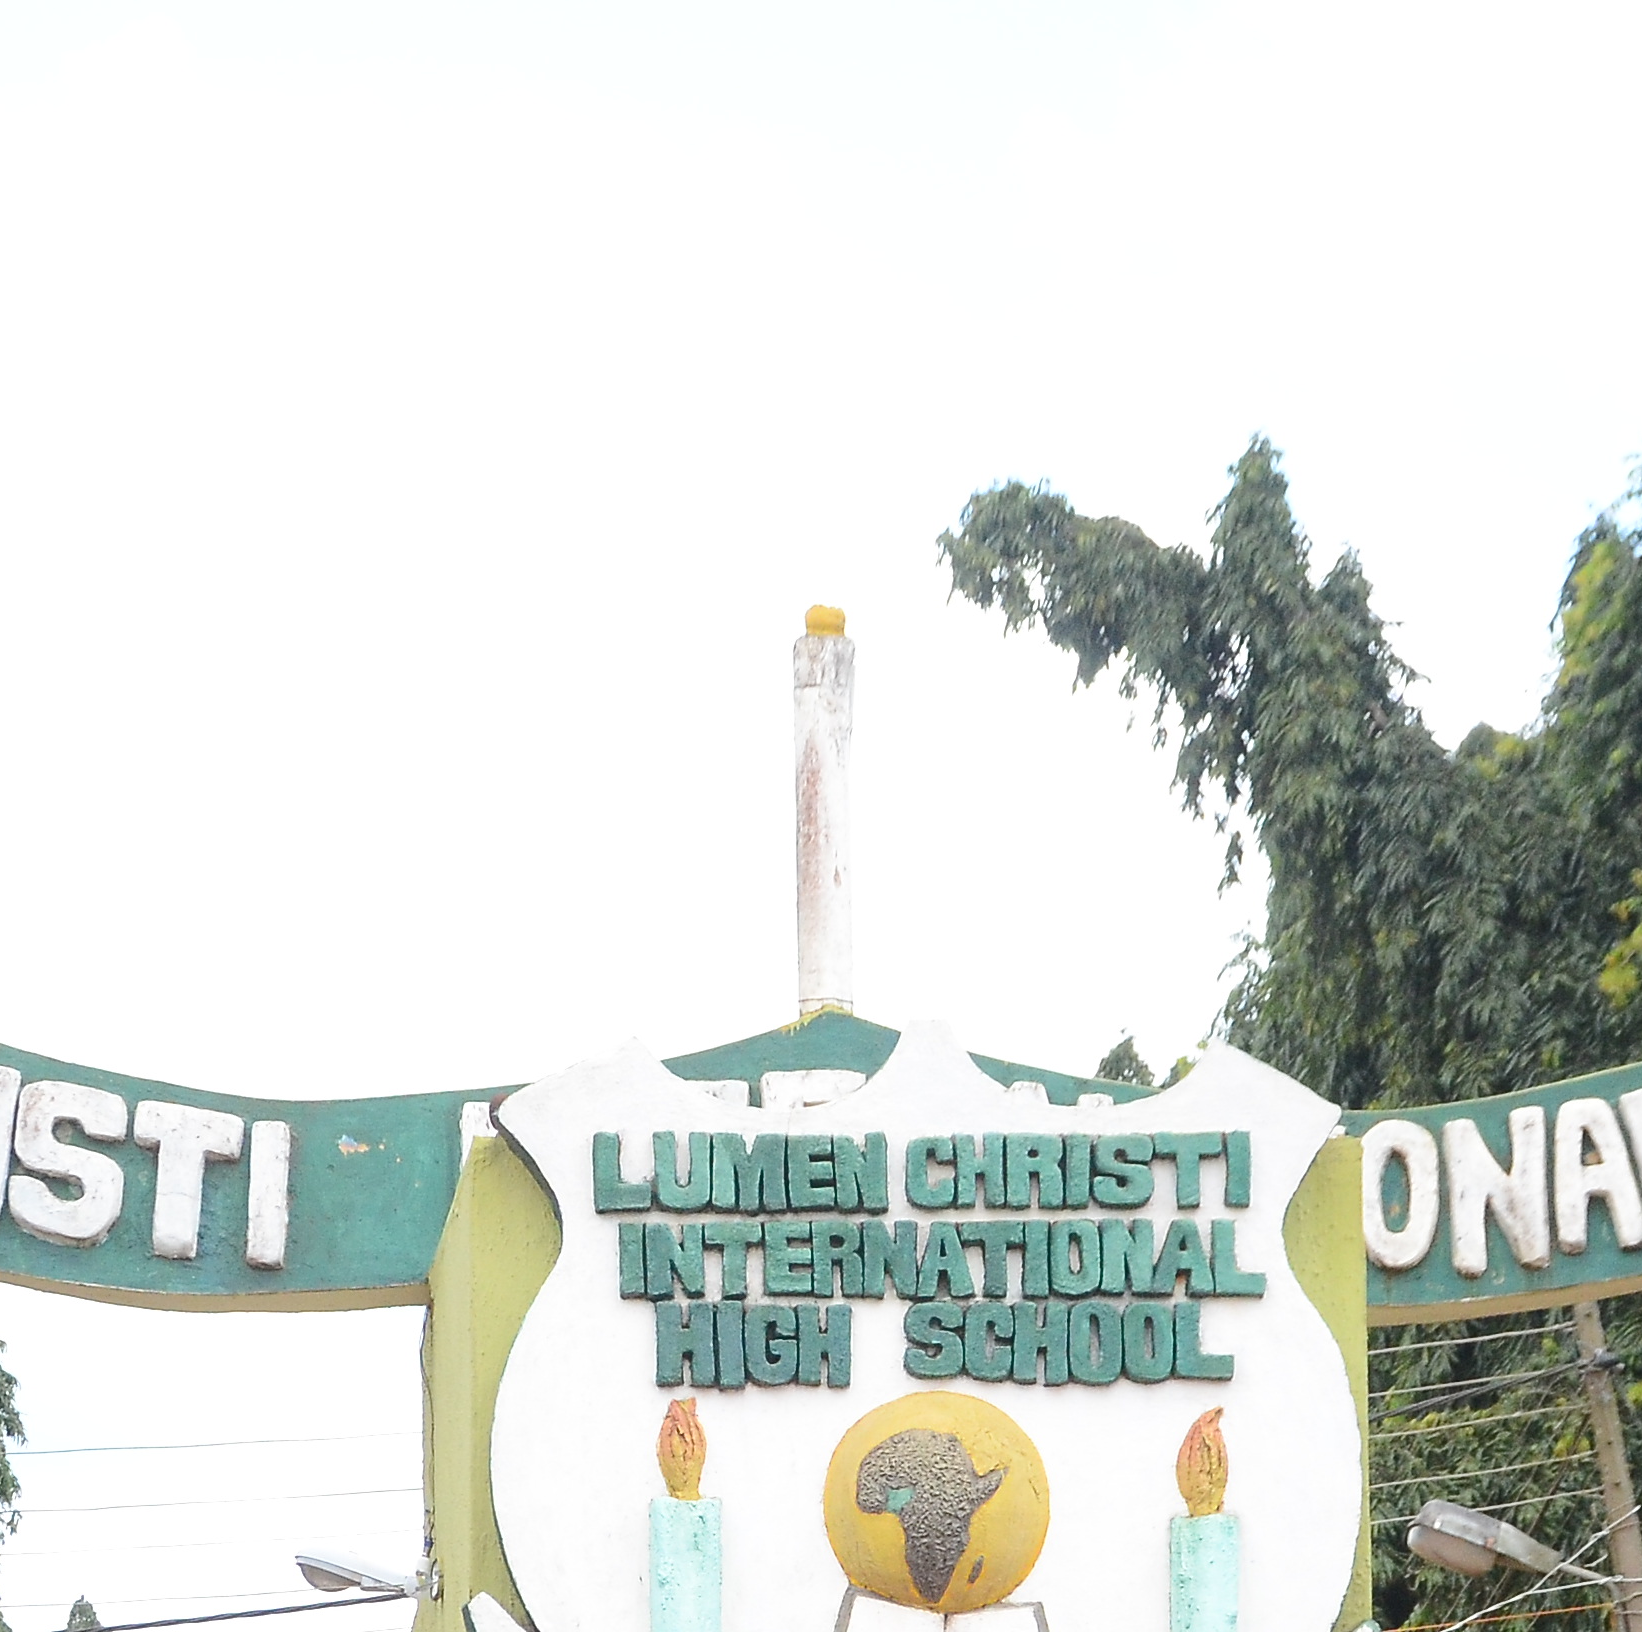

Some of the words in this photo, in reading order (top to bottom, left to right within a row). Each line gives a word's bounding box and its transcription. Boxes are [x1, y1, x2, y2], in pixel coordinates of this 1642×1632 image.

[593, 1131, 889, 1214] LUMEN
[905, 1131, 1252, 1211] CHRISTI
[618, 1218, 1266, 1300] INTERNATIONAL
[655, 1302, 851, 1390] HIGH
[903, 1302, 1234, 1388] SCHOOL
